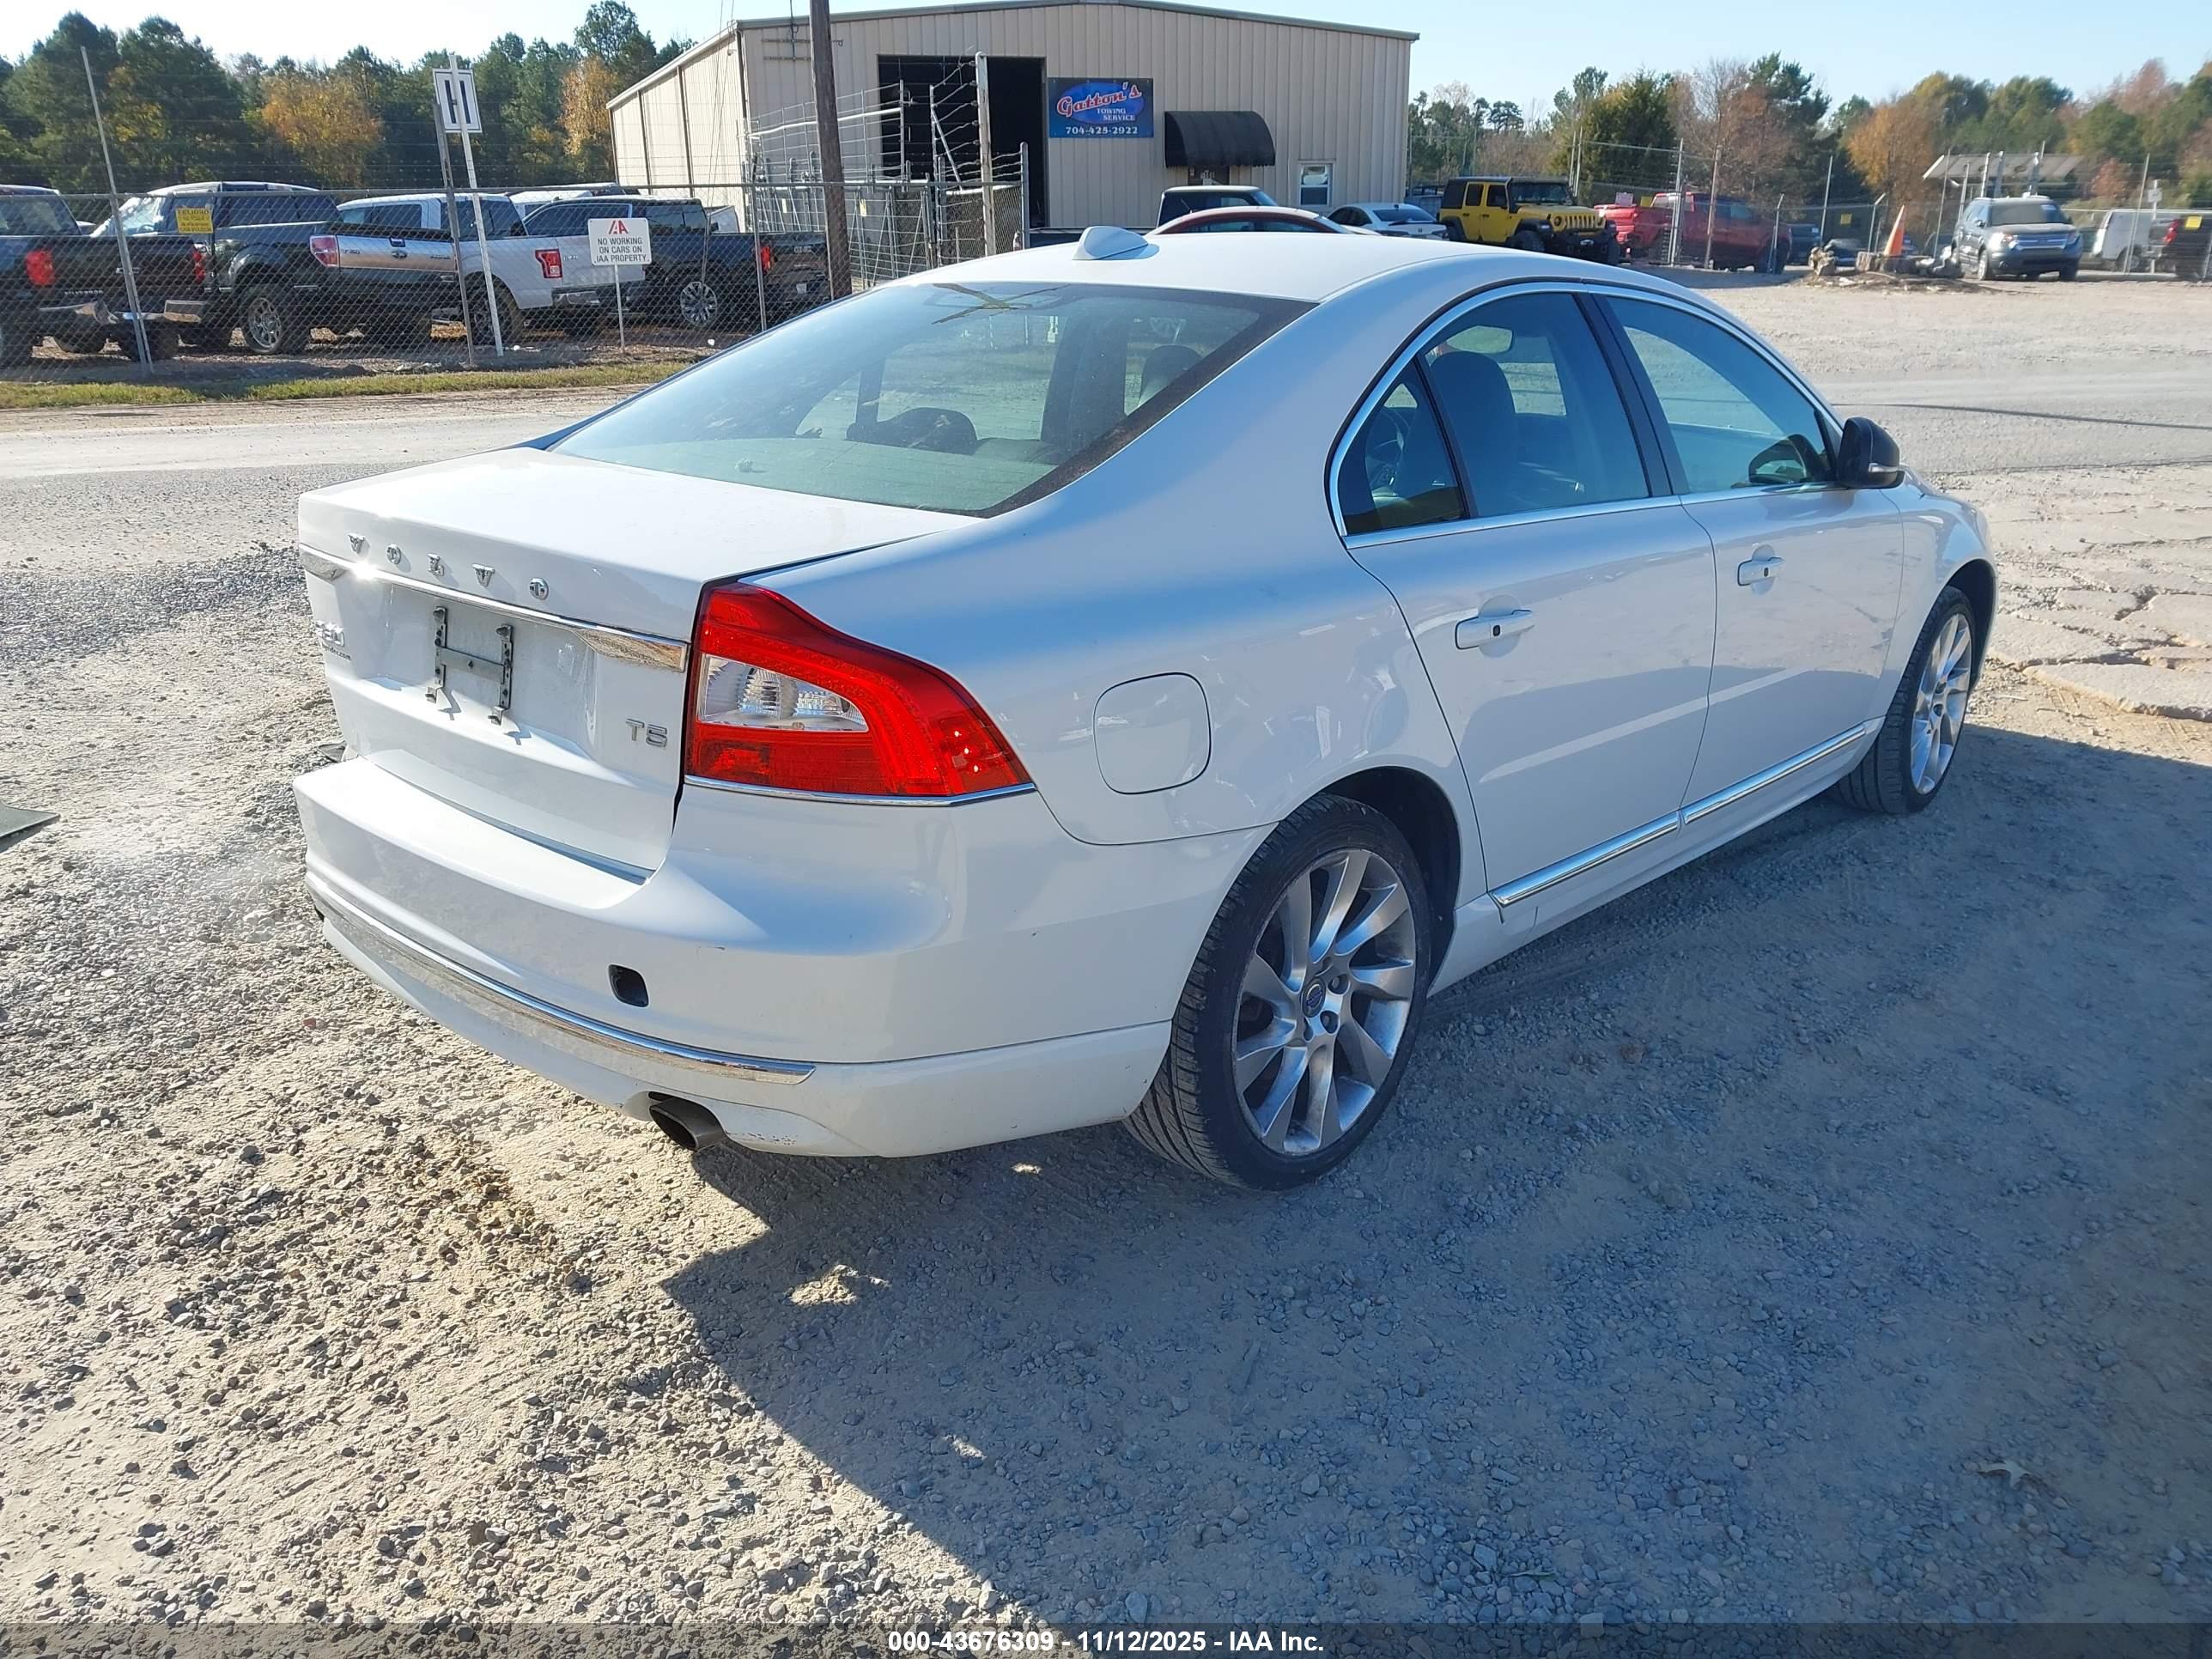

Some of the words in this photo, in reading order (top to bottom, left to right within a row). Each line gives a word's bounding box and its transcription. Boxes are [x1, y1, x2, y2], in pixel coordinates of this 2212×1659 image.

[1056, 82, 1142, 118] Gatton's
[610, 237, 643, 246] WORKING
[348, 532, 550, 601] VOLVO
[625, 718, 668, 748] T5
